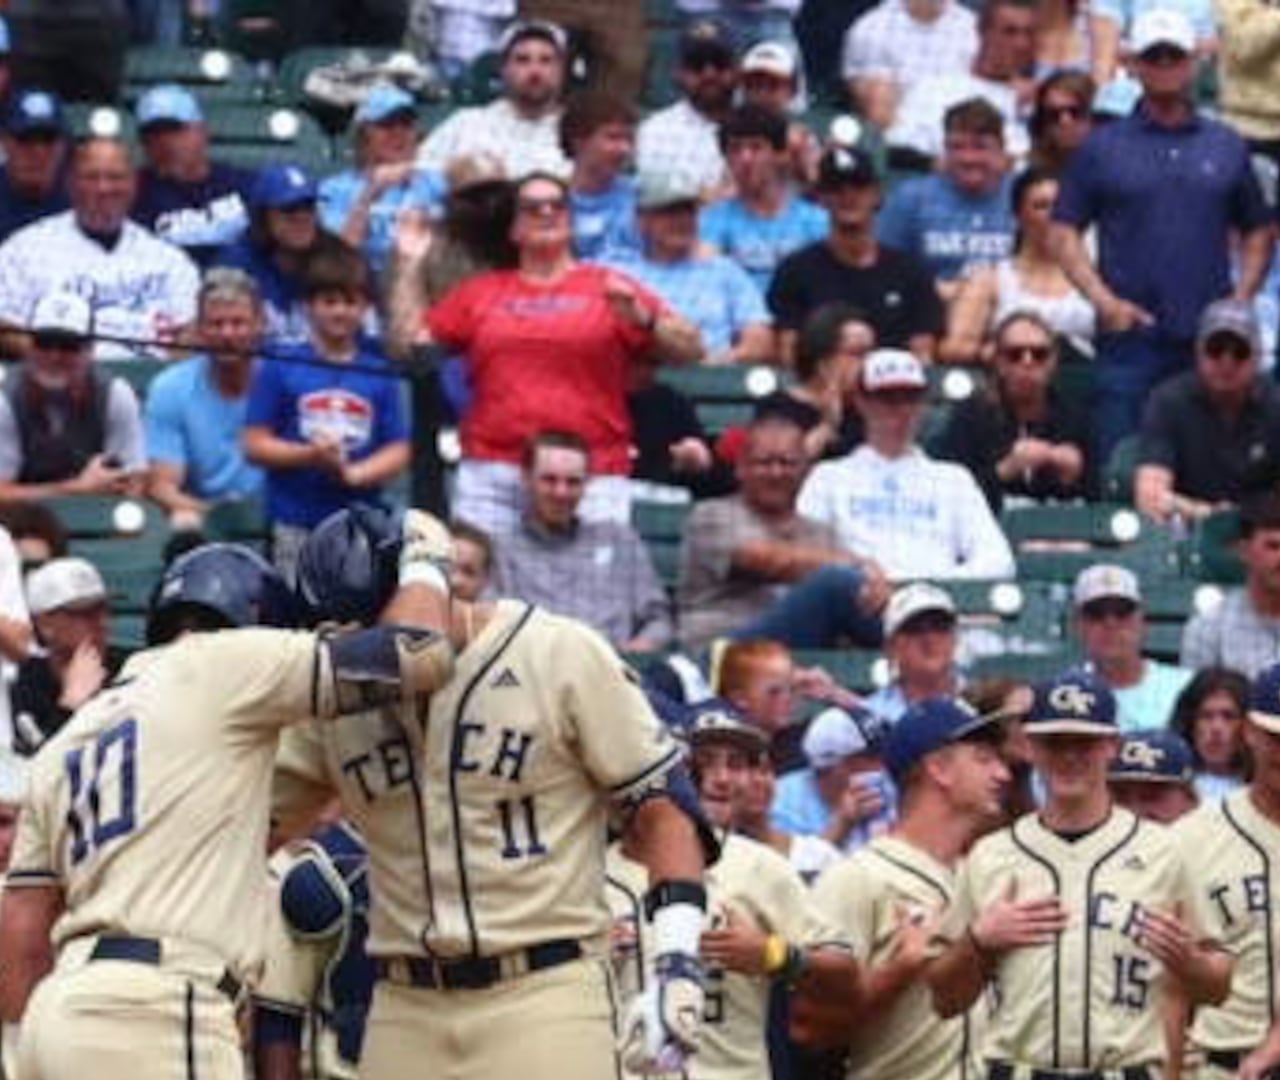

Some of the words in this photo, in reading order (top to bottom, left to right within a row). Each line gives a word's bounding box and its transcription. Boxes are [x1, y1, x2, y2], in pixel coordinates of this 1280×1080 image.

[63, 717, 138, 866] 10
[342, 722, 533, 803] TECH
[501, 796, 547, 859] 11
[1210, 875, 1269, 928] TE
[1112, 954, 1148, 1010] 15
